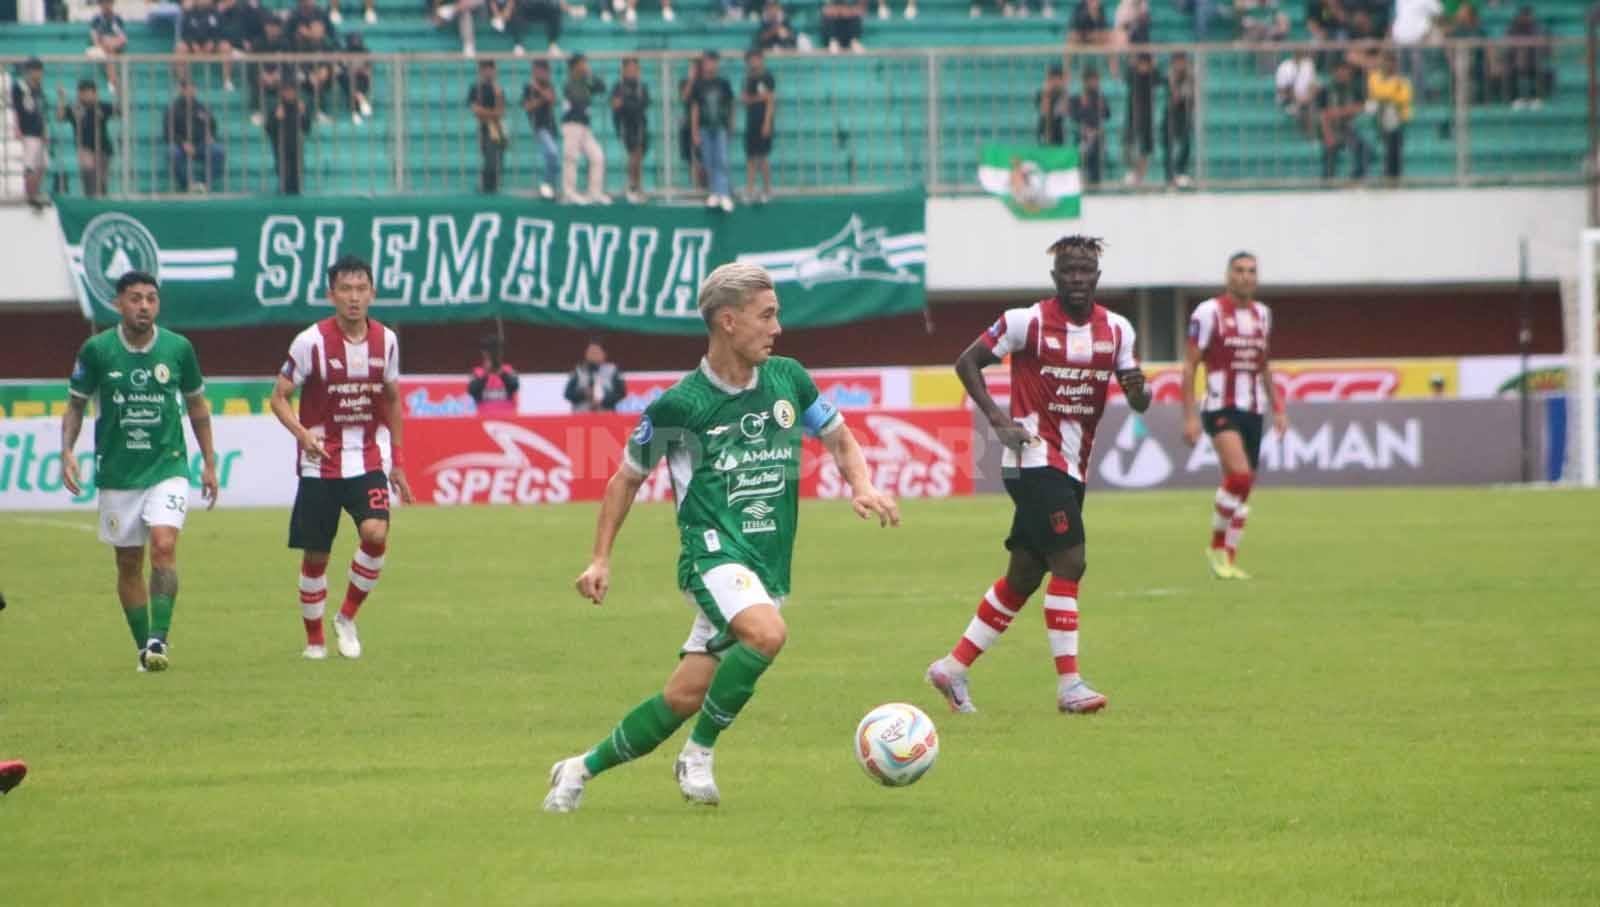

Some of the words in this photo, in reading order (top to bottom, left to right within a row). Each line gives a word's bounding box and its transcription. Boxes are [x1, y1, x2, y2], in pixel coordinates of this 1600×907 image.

[256, 213, 713, 318] SLEMANIA
[743, 448, 793, 463] AMMAN
[433, 467, 573, 504] SPECS
[816, 461, 955, 497] SECS
